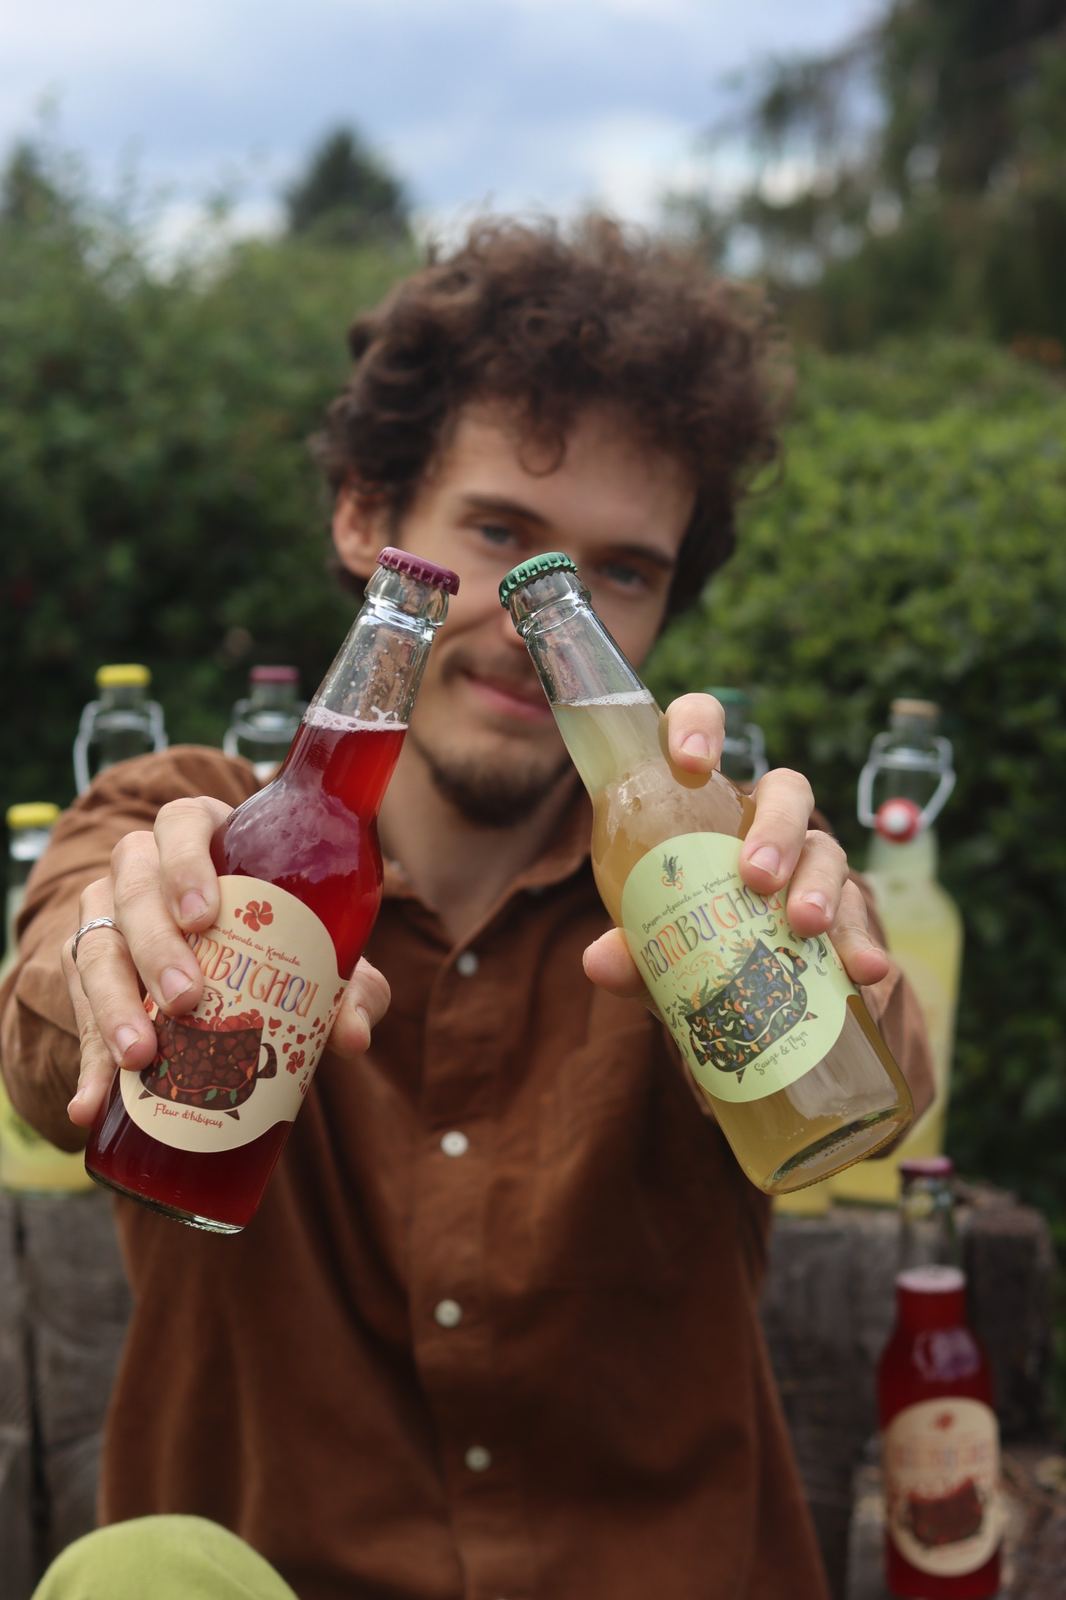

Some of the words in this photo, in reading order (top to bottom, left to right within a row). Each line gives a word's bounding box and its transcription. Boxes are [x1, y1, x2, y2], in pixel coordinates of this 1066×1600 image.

[254, 943, 264, 952] au
[266, 946, 301, 966] Kombucha
[754, 1053, 779, 1076] Sauge
[779, 1045, 790, 1056] &
[153, 1103, 180, 1117] Fleur
[181, 1110, 223, 1128] d'hibiscus
